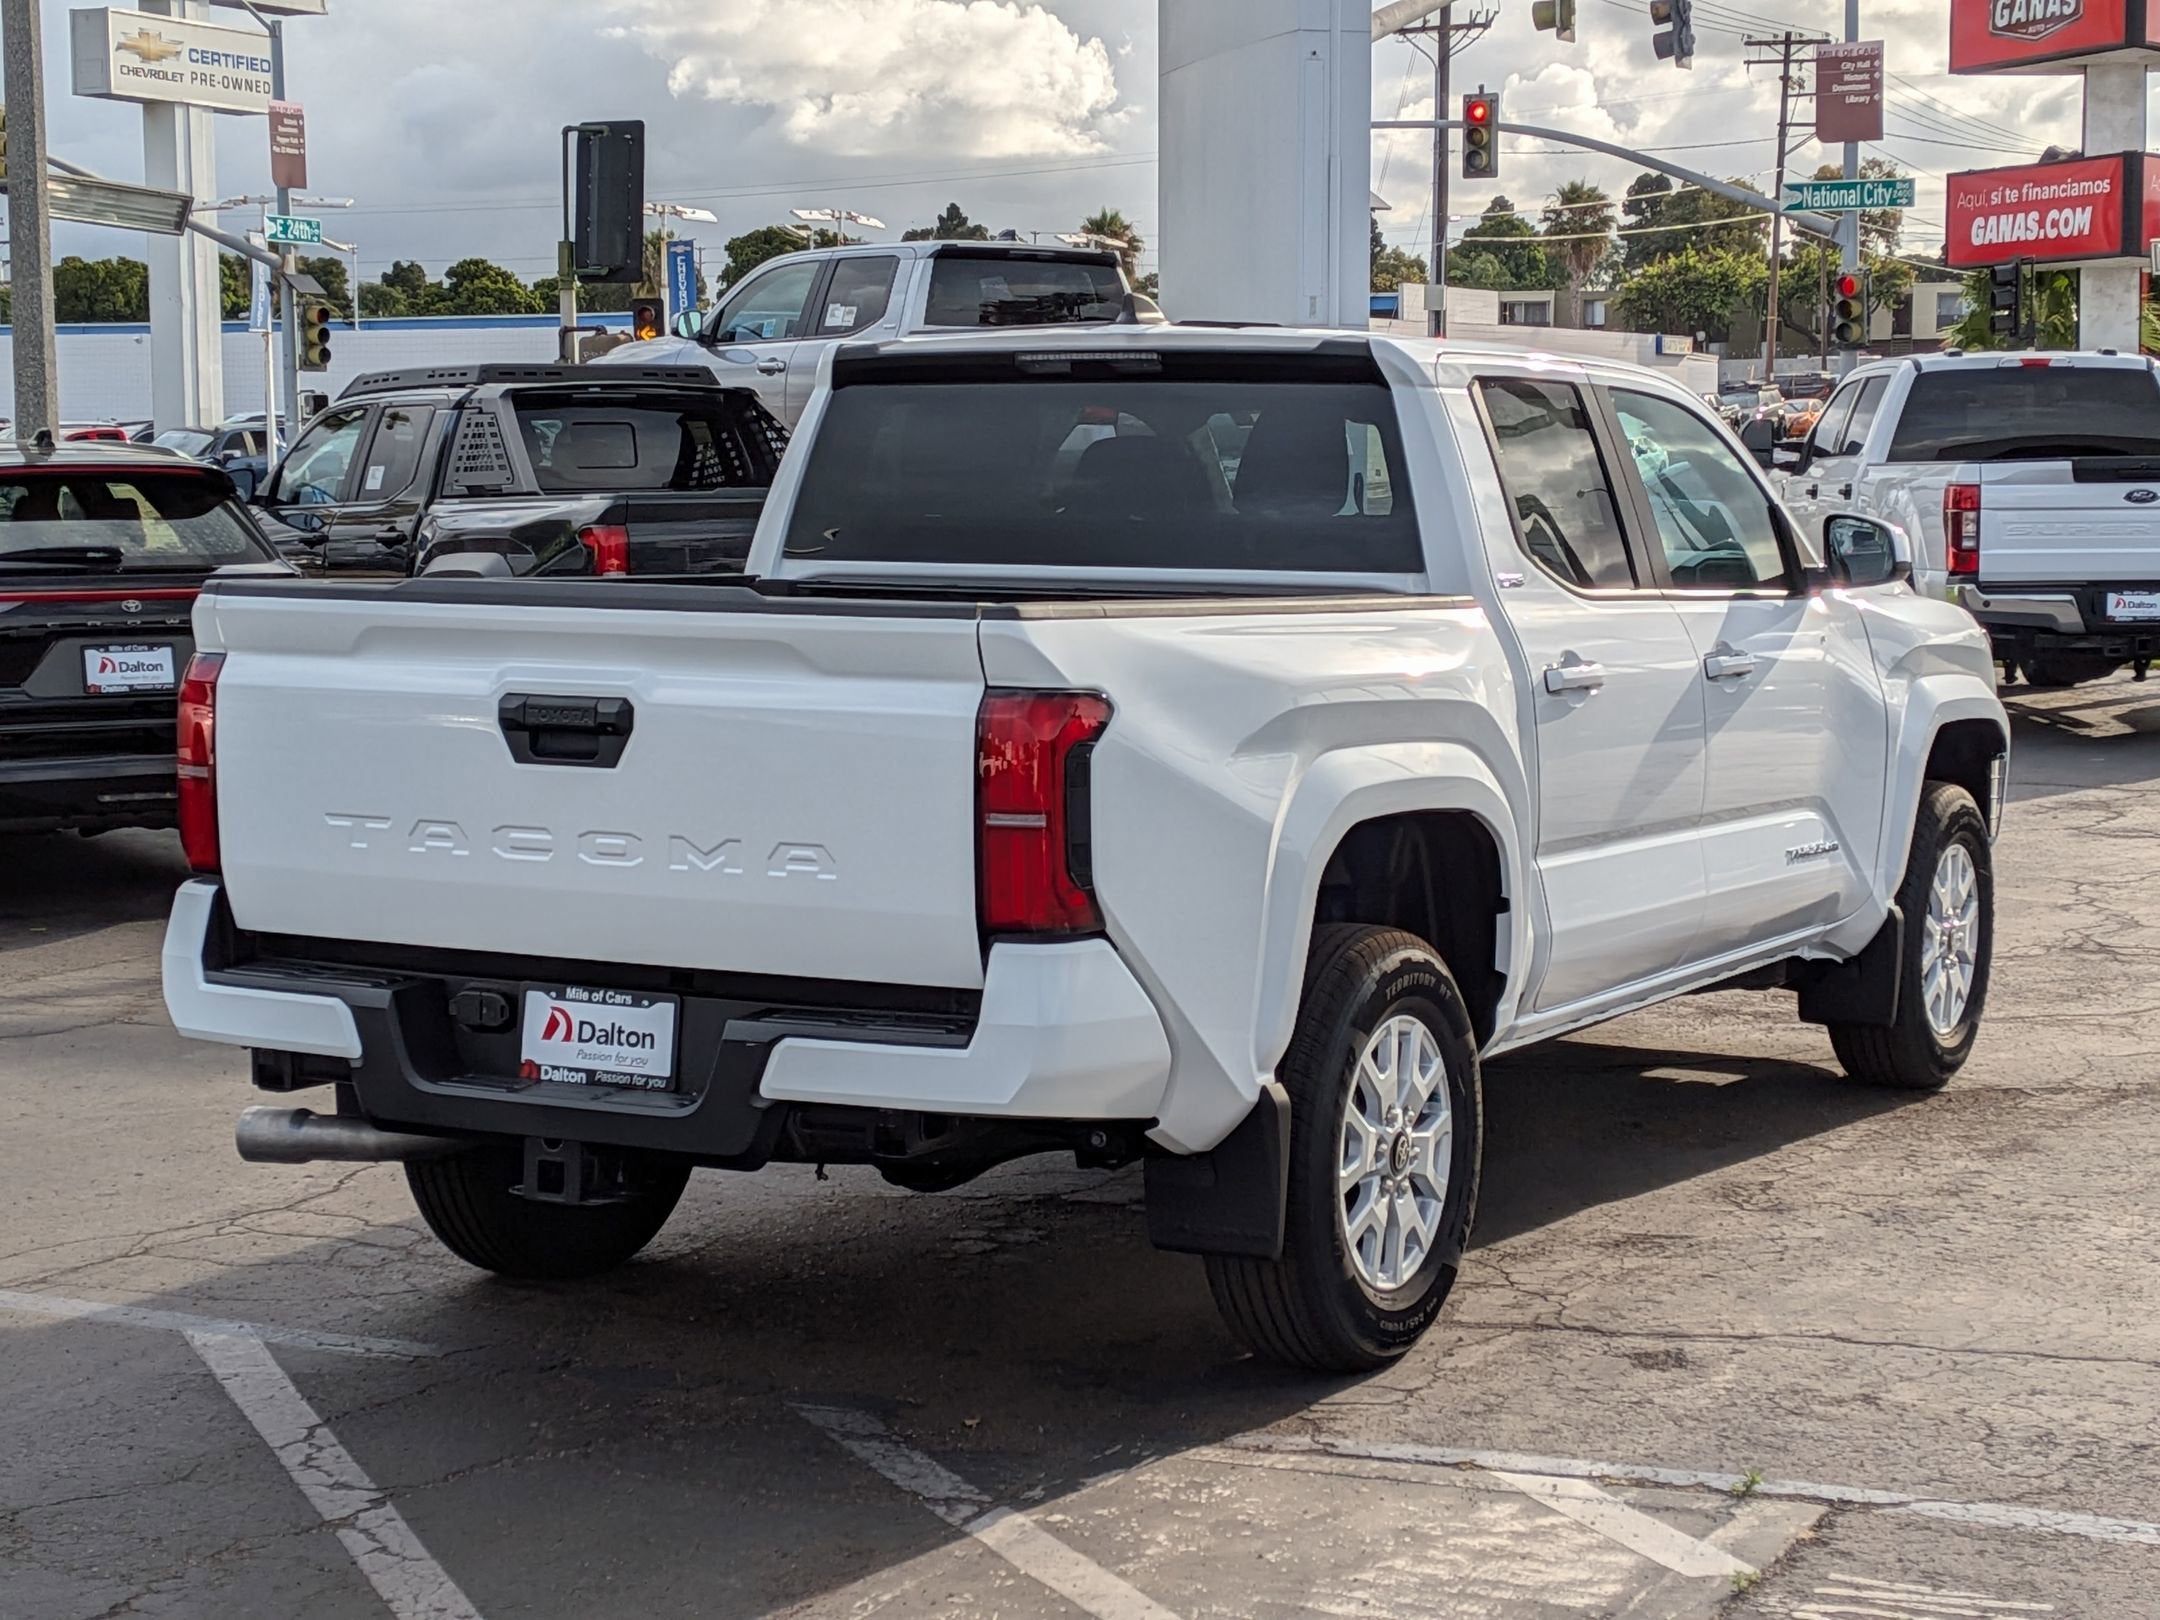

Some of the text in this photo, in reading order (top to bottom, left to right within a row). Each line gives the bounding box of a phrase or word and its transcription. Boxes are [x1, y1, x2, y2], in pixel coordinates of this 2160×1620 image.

[188, 48, 271, 73] CERTIFIED
[120, 64, 184, 83] CHEVROLET
[190, 71, 271, 95] PRE-OWNED
[1845, 94, 1871, 104] Library
[1802, 182, 1893, 209] National City
[2006, 185, 2019, 204] te
[2022, 177, 2111, 202] financiamos
[276, 219, 312, 241] E 24th
[1970, 205, 2093, 247] GANAS.COM
[2127, 600, 2157, 609] Dalton
[118, 661, 164, 672] Dalton
[324, 812, 838, 881] TACOMA
[565, 986, 632, 1005] Mile of Cars
[577, 1020, 655, 1049] Dalton
[576, 1049, 649, 1066] Passion for you
[540, 1065, 667, 1089] Dalton Passion for you
